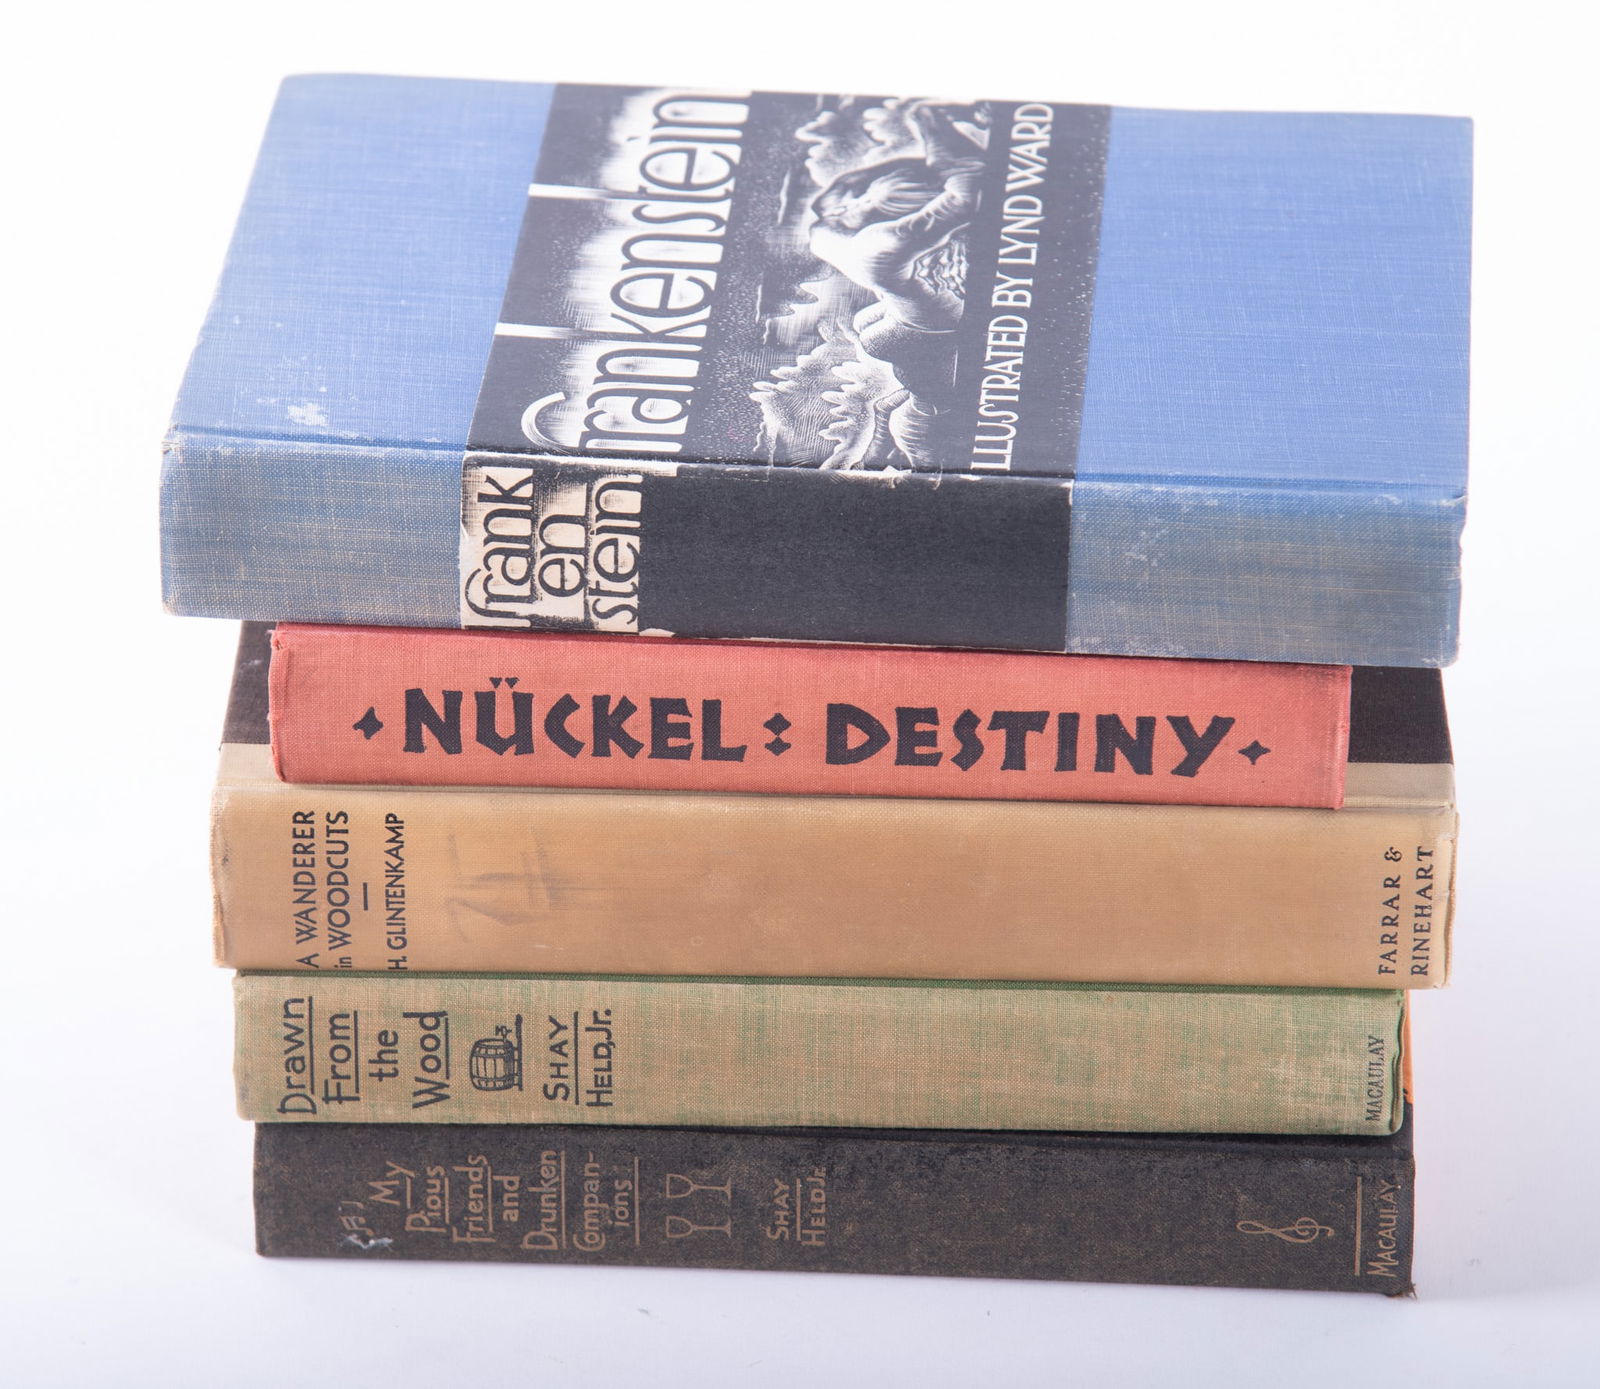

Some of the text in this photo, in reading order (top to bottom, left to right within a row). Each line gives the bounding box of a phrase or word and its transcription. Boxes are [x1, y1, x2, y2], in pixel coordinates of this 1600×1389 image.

[968, 102, 1056, 472] LLUSTRATED BY LYND WARD
[537, 514, 588, 598] en
[403, 676, 1236, 777] NÜCKEL DESTINY
[292, 810, 319, 969] A WANDERER
[325, 810, 352, 970] in WOODCUTS
[384, 813, 408, 972] H. GLINTENKAMP
[1378, 846, 1403, 976] FARRAR &
[1410, 845, 1434, 977] RINEHART
[278, 997, 317, 1115] Drawn
[322, 1011, 360, 1105] From
[369, 1028, 399, 1083] the
[402, 1010, 450, 1109] Wood
[542, 1014, 570, 1101] SHAY
[1365, 1035, 1386, 1122] MACAULAY
[368, 1161, 416, 1206] My
[405, 1164, 448, 1233] Pious
[452, 1154, 497, 1243] Friends
[493, 1175, 521, 1223] and
[521, 1150, 560, 1250] Drunken
[573, 1151, 610, 1251] Compan-
[608, 1178, 633, 1228] ions
[760, 1178, 790, 1241] SHAY
[1366, 1178, 1400, 1278] MACAULAY
